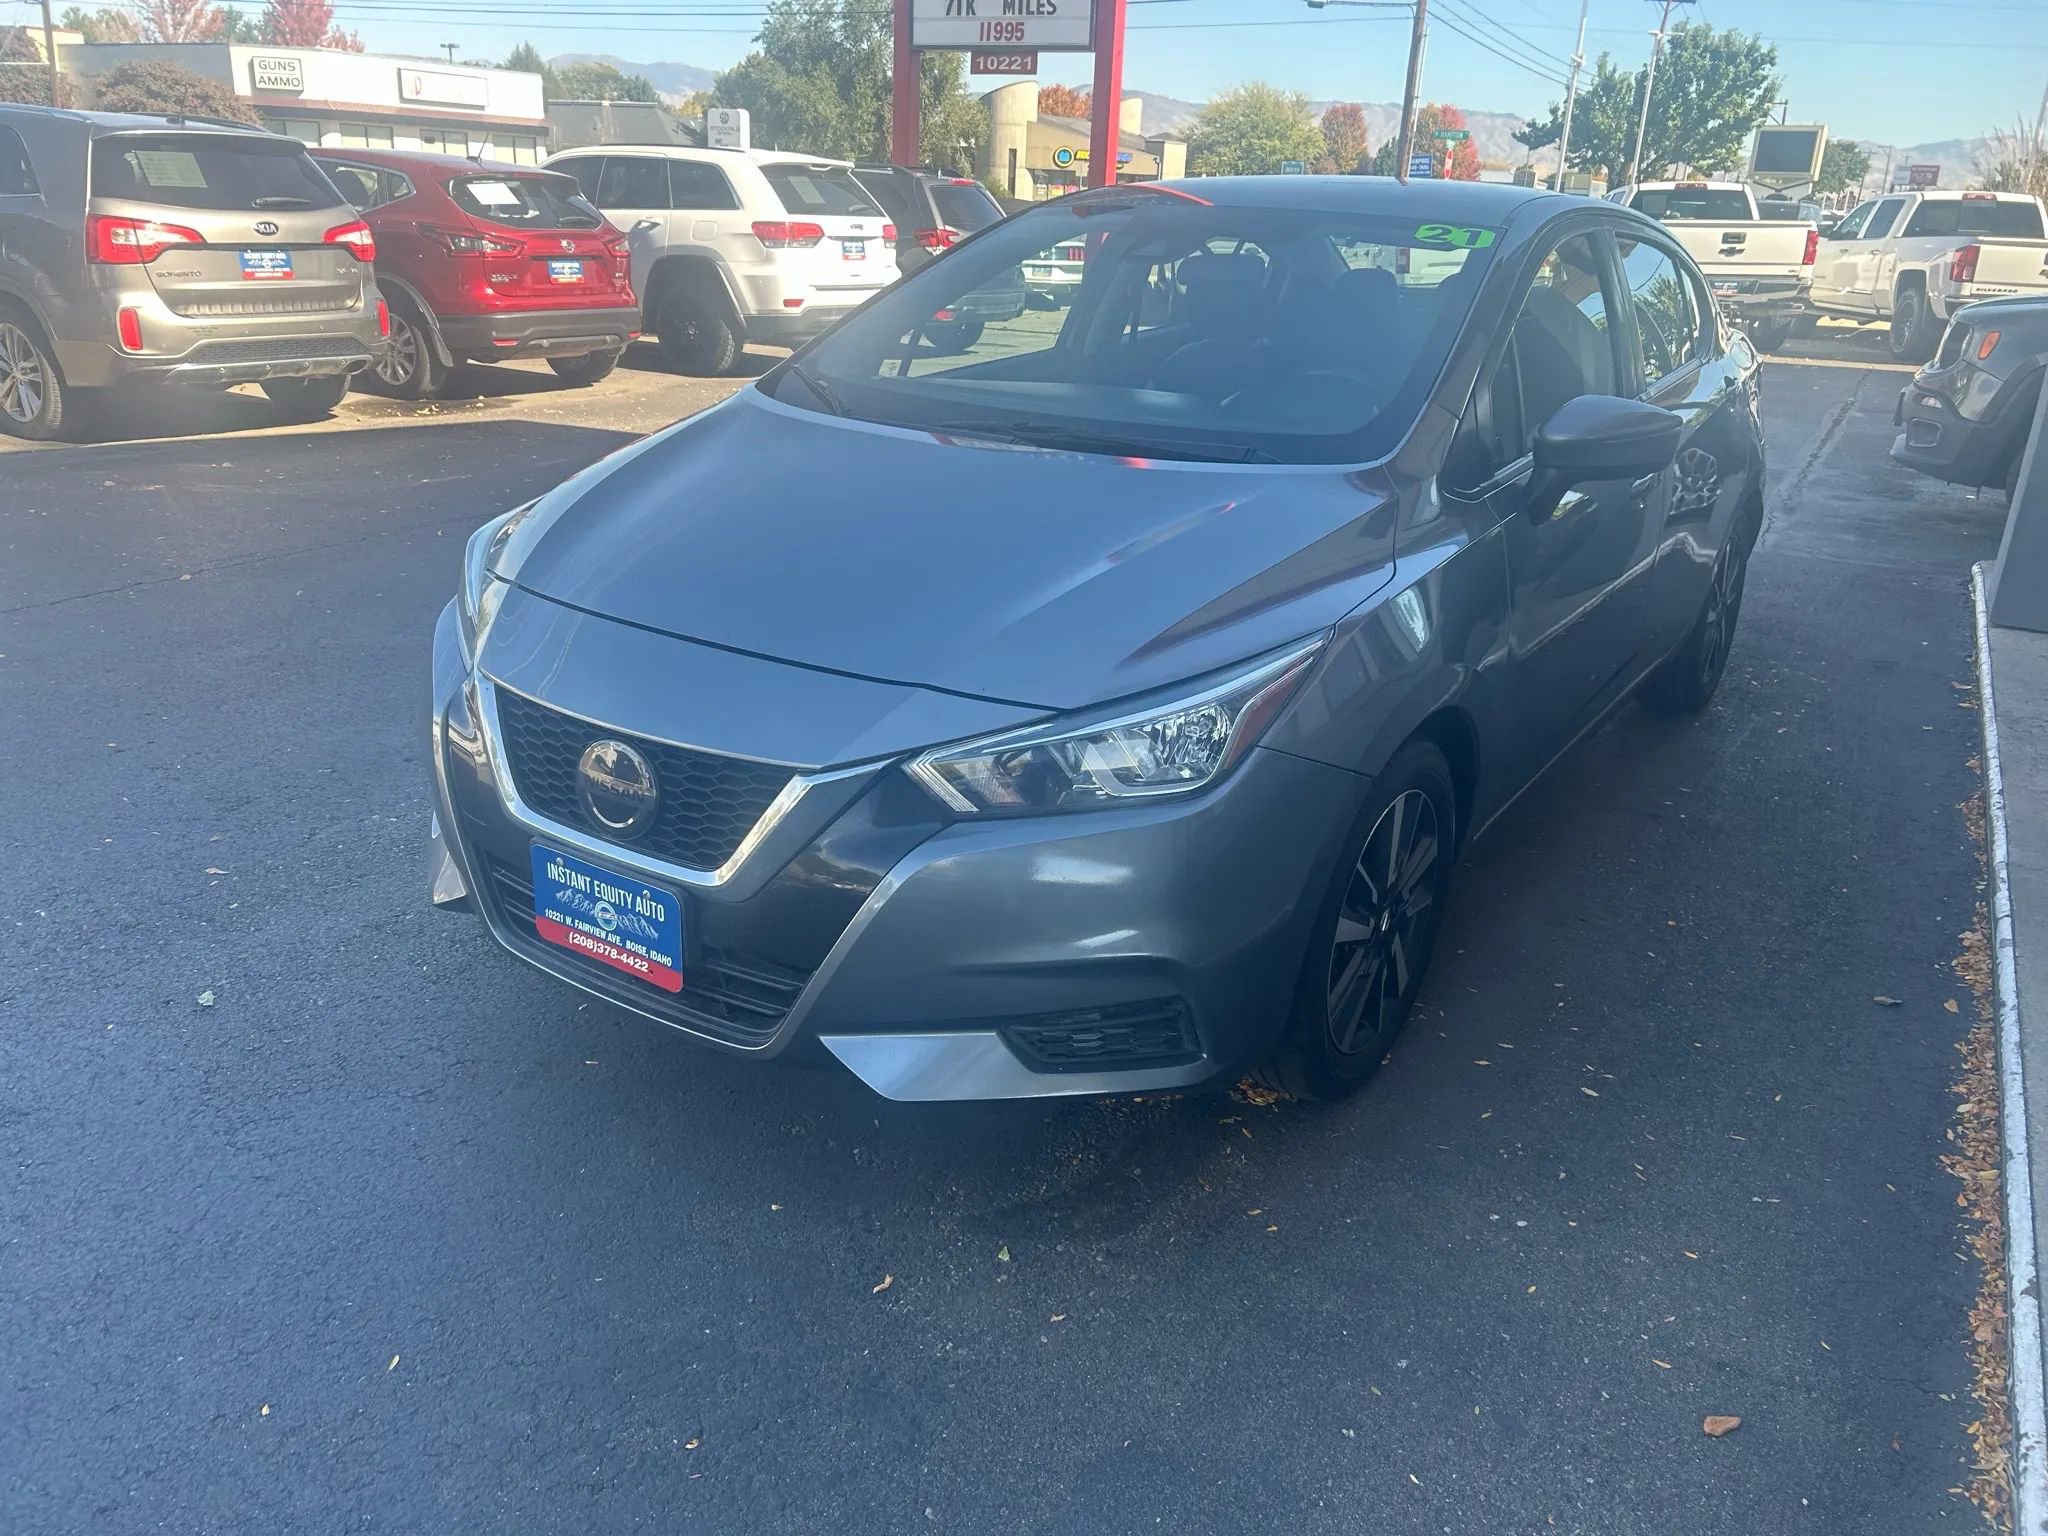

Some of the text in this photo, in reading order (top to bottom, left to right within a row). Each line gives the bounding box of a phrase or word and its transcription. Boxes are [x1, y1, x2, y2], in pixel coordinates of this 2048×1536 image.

[1002, 0, 1057, 16] MILES
[979, 21, 1025, 42] 11995
[258, 59, 296, 71] GUNS
[976, 56, 1033, 71] 10221
[258, 75, 301, 88] AMMO
[253, 223, 277, 233] KIA
[1419, 226, 1482, 246] 21
[155, 270, 202, 278] SORENTO
[546, 861, 665, 922] INSTANT EQUITY AUTO
[544, 908, 672, 967] 10221 W. FAIRVIEW AVE. BOISE, IDAHO
[568, 931, 649, 972] (208)378-4422
